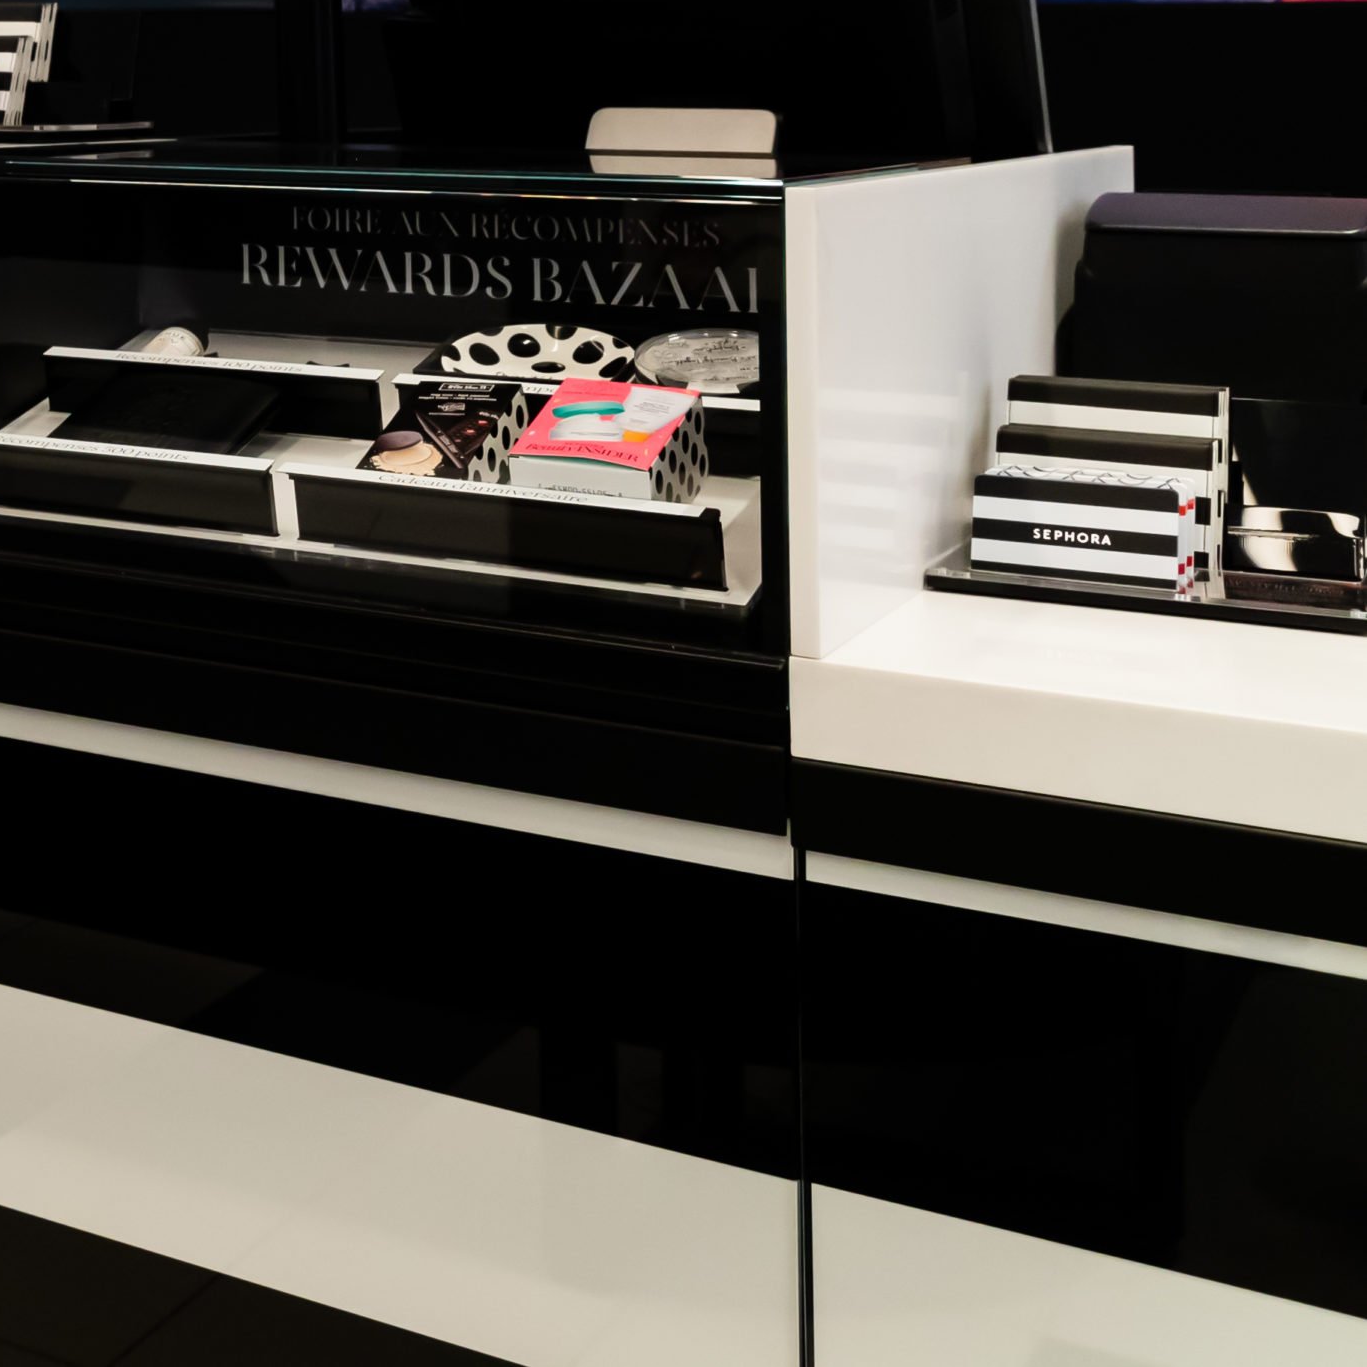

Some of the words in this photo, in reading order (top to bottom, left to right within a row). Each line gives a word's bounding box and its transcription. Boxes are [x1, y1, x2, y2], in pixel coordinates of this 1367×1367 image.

[292, 205, 382, 234] FOIRE
[395, 209, 461, 238] AUX
[240, 242, 514, 301] REWARDS
[134, 449, 190, 461] points
[573, 445, 640, 464] INSIDER
[377, 473, 448, 490] Cadeau
[1032, 527, 1112, 546] SEPHORA
